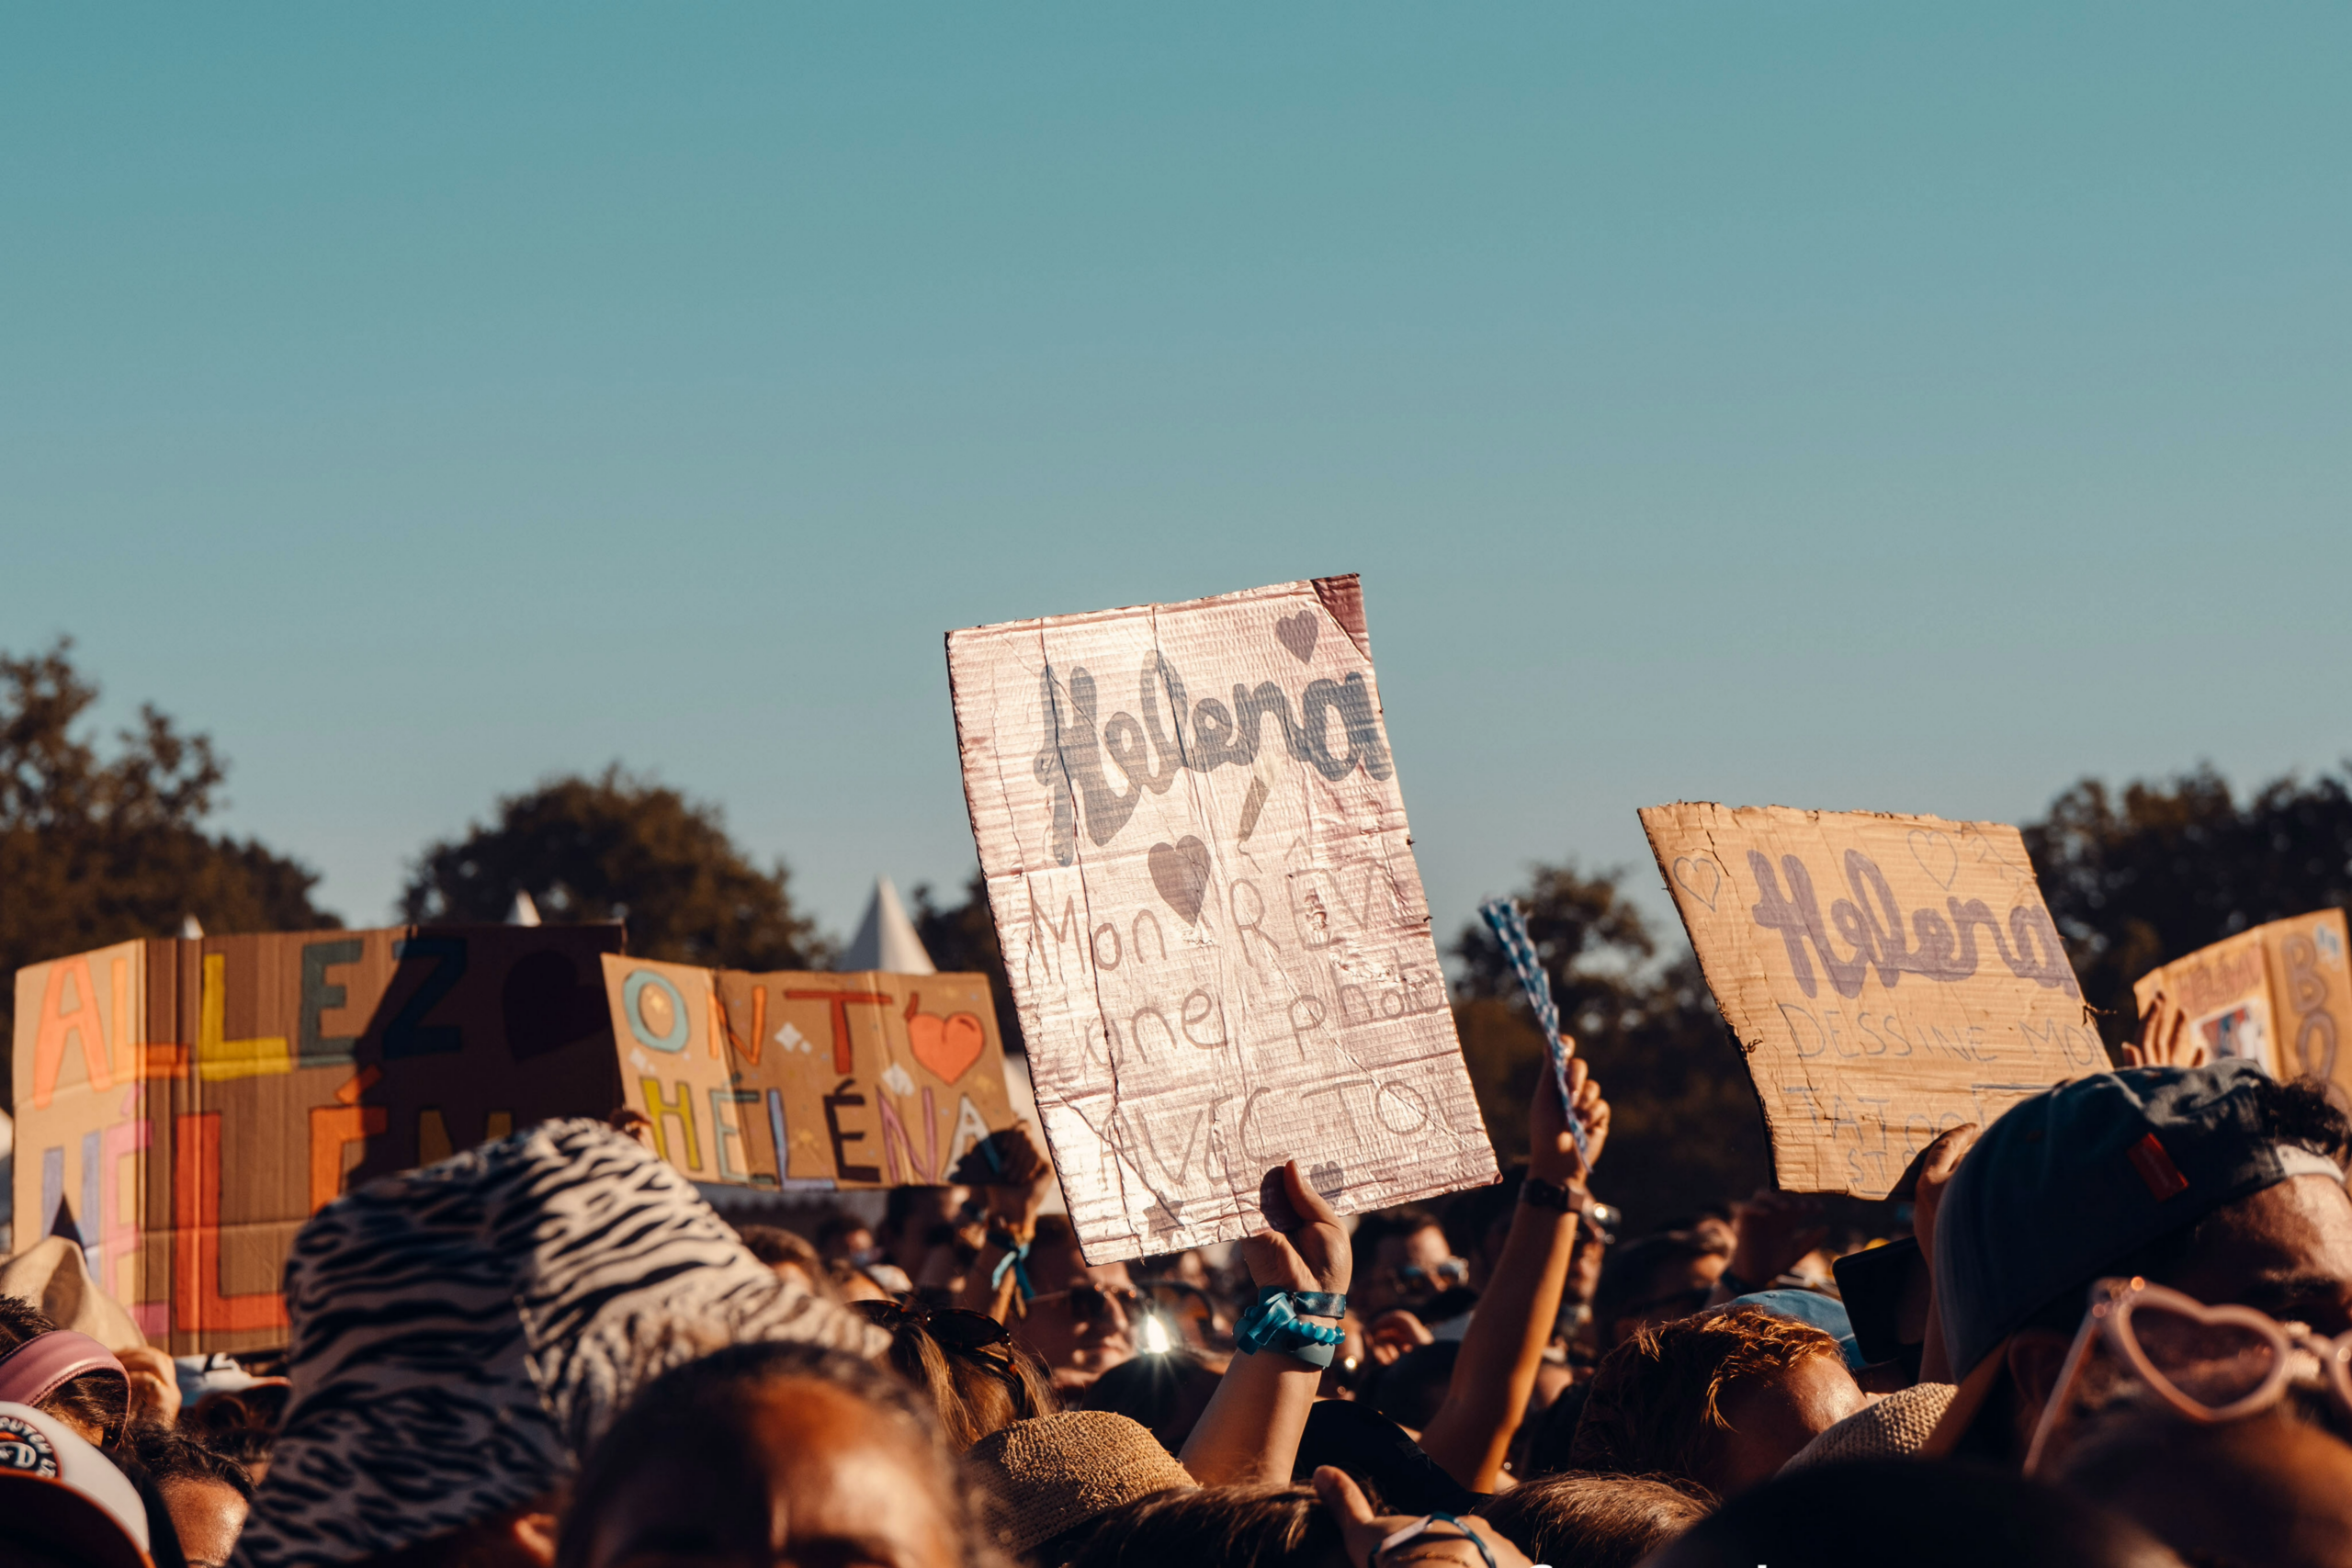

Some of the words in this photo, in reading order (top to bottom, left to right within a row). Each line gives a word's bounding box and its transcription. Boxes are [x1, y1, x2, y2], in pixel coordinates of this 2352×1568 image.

[34, 938, 468, 1110] ALLEZ
[623, 968, 767, 1067] ON
[1100, 1086, 1292, 1190] AVEC
